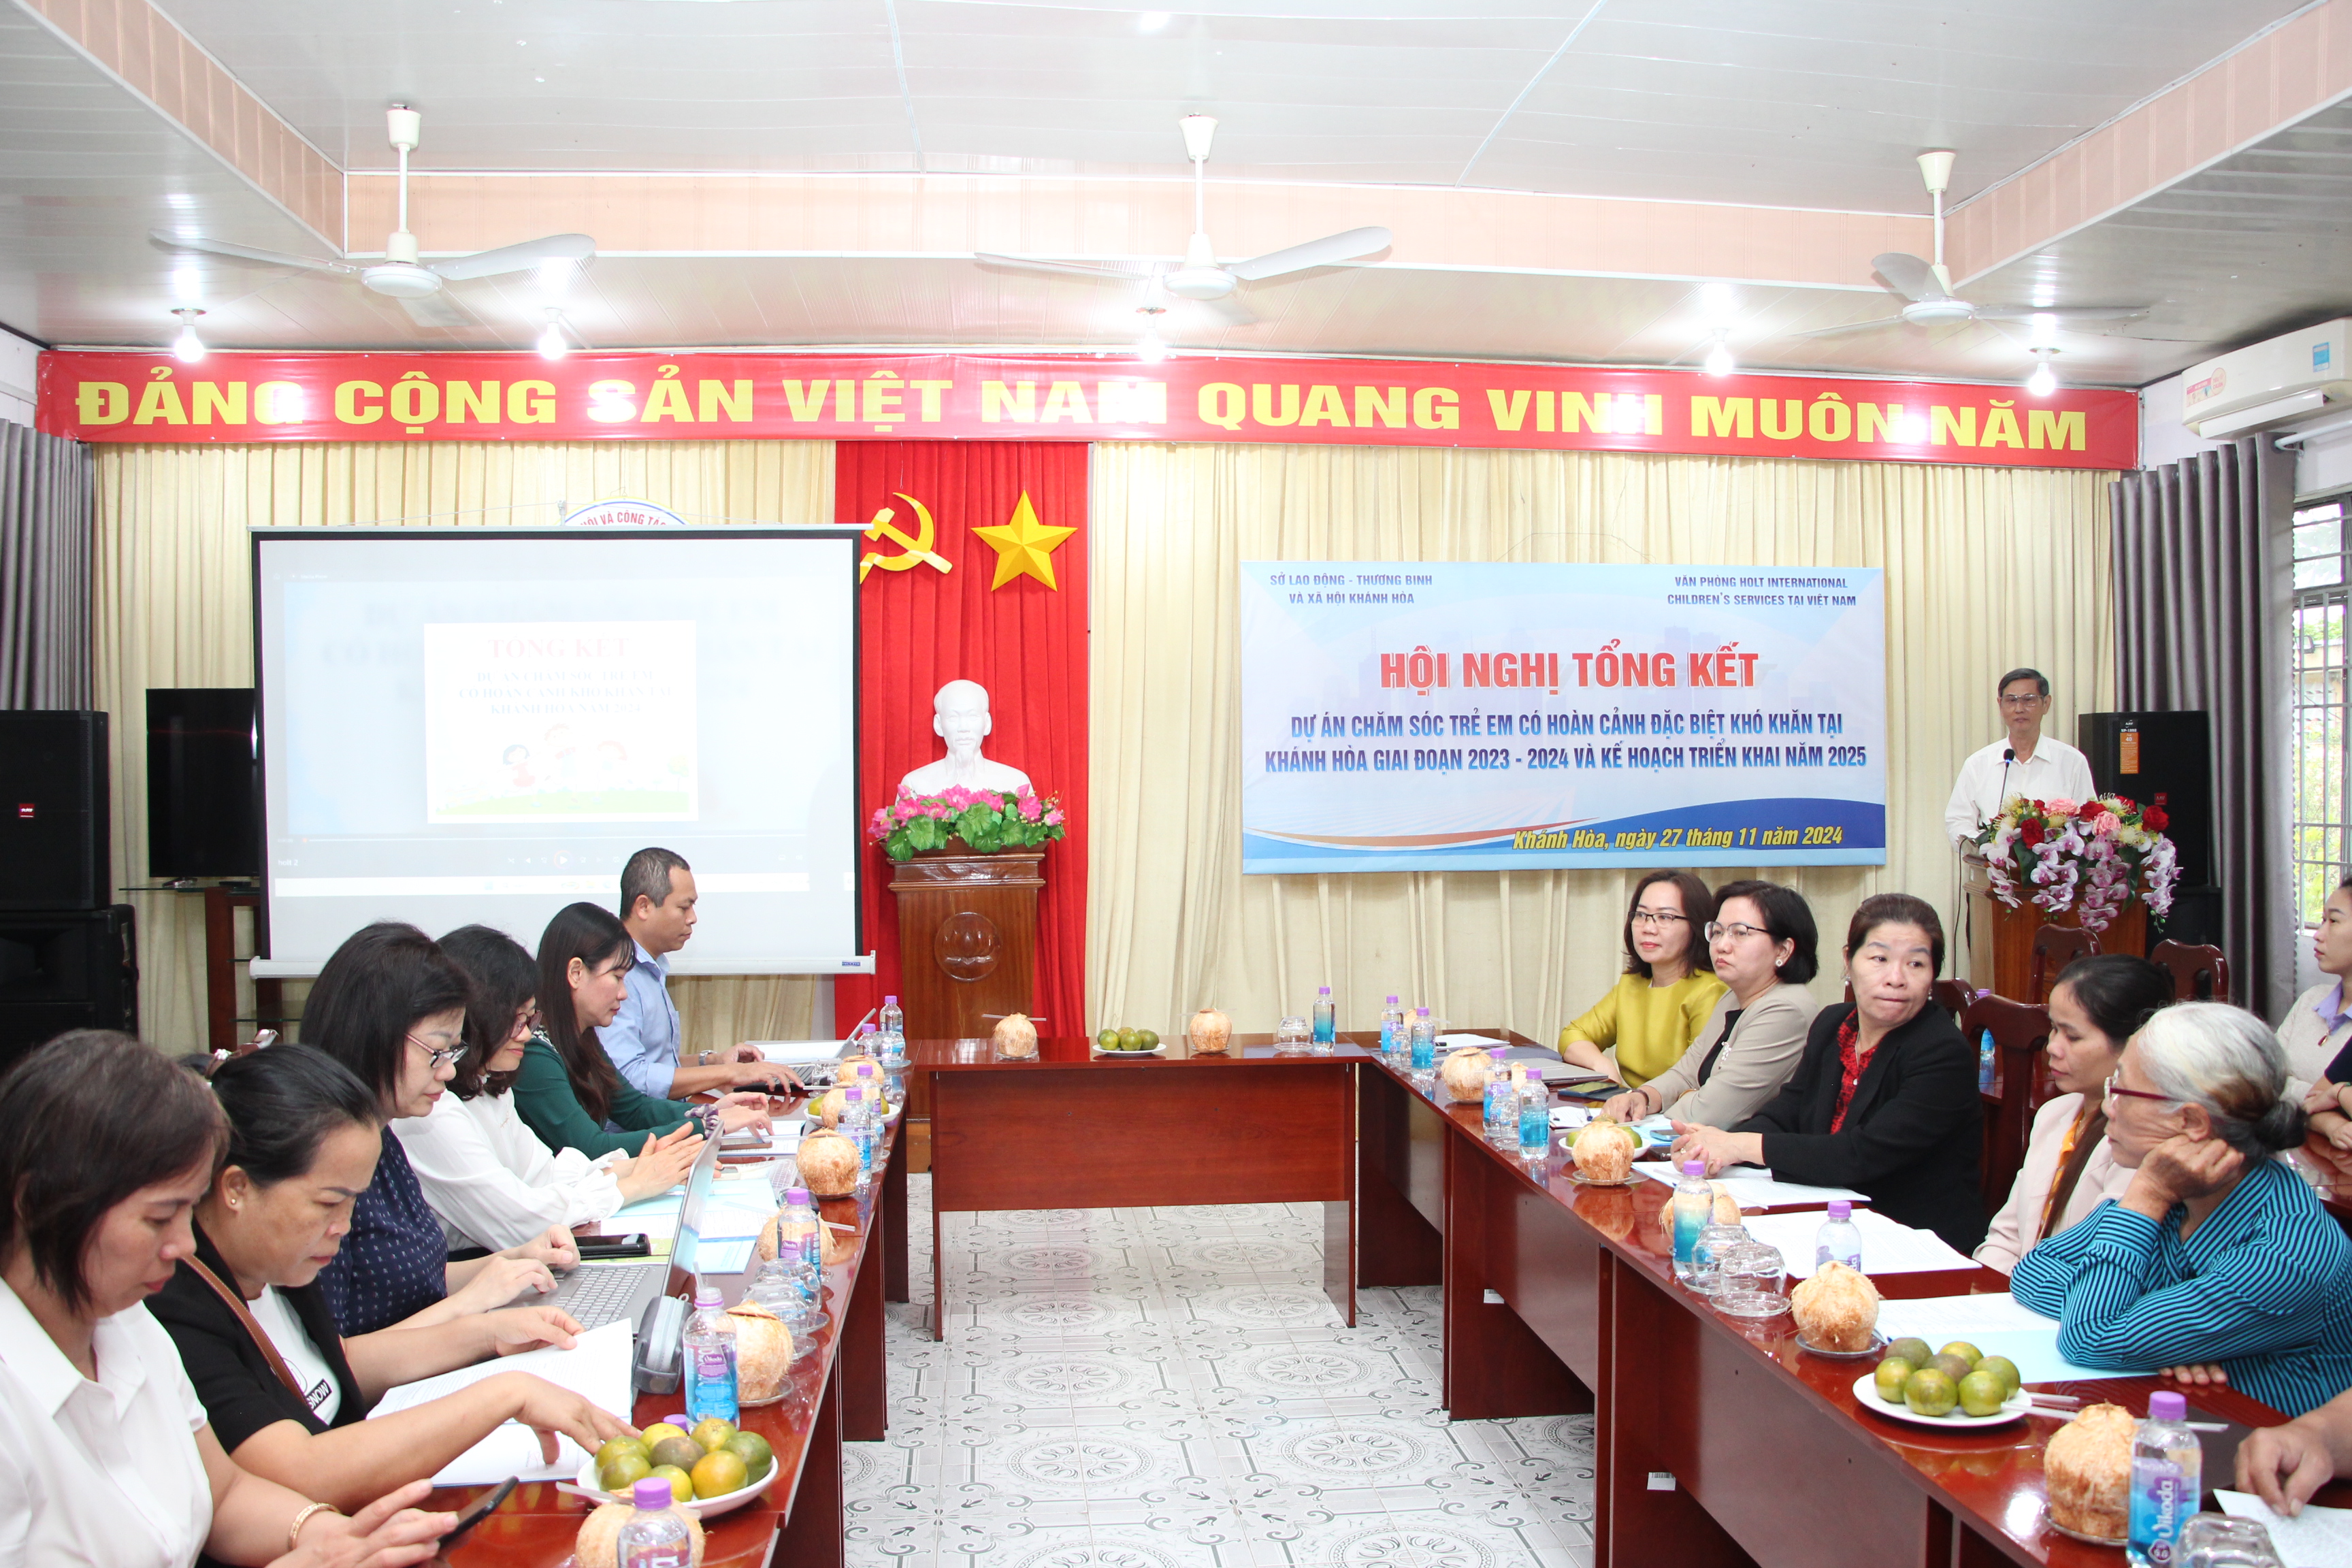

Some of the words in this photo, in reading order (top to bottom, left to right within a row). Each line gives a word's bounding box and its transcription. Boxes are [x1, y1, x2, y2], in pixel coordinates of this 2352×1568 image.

[76, 366, 304, 425] ĐẢNG
[334, 371, 556, 434] CỘNG
[587, 364, 753, 423] SẢN
[782, 371, 953, 431] VIỆT
[981, 379, 1167, 424] NAM
[1198, 382, 1459, 430] QUANG
[1486, 389, 1662, 436] VINH
[1691, 392, 1910, 444] MUÔN
[1930, 399, 2085, 451] NĂM
[600, 512, 614, 525] VÀ
[617, 510, 644, 525] CÔNG
[1270, 572, 1286, 585] SỞ
[1289, 574, 1309, 585] LAO
[1313, 573, 1345, 587] ĐỘNG
[1356, 574, 1402, 585] THƯƠNG
[1405, 575, 1433, 585] BINH
[1675, 574, 1697, 587] VĂN
[1700, 574, 1737, 588] PHÒNG
[1740, 577, 1765, 588] HOLT
[1767, 577, 1848, 589] INTERNATIONAL
[1289, 591, 1304, 604] VÀ
[1307, 591, 1323, 604] XÃ
[1326, 591, 1345, 606] HỘI
[1349, 591, 1388, 604] KHÁNH
[1392, 591, 1414, 604] HÒA
[1734, 594, 1784, 606] SERVICES
[1787, 595, 1804, 607] TẠI
[1807, 593, 1829, 608] VIỆT
[1832, 595, 1856, 606] NAM
[1380, 645, 1450, 696] HỘI
[1463, 652, 1559, 696] NGHỊ
[1571, 638, 1676, 687] TỔNG
[1687, 642, 1759, 687] KẾT
[1291, 714, 1316, 742] DỰ
[1321, 712, 1345, 738] ÁN
[1351, 712, 1403, 737] CHĂM
[1409, 710, 1443, 736] SÓC
[1450, 707, 1480, 736] TRẺ
[1486, 715, 1513, 736] EM
[1519, 710, 1541, 736] CÓ
[1547, 710, 1594, 736] HOÀN
[1599, 706, 1646, 735] CẢNH
[1651, 709, 1684, 739] ĐẶC
[1690, 710, 1725, 739] BIỆT
[1730, 709, 1763, 734] KHÓ
[1769, 709, 1812, 734] KHĂN
[1818, 713, 1843, 738] TẠI
[1265, 747, 1326, 772] KHÁNH
[1332, 745, 1368, 772] HÒA
[1373, 749, 1408, 771] GIAI
[1414, 749, 1463, 775] ĐOẠN
[1467, 748, 1509, 770] 2023
[1527, 748, 1569, 770] 2024
[1574, 743, 1596, 768] VÀ
[1601, 740, 1624, 768] KẾ
[1628, 745, 1684, 773] HOẠCH
[1688, 738, 1736, 768] TRIỂN
[1742, 746, 1780, 768] KHAI
[1786, 742, 1823, 767] NĂM
[1828, 745, 1866, 766] 2025
[1512, 830, 1569, 850] Khánh
[1572, 829, 1610, 850] Hòa,
[1614, 828, 1657, 850] ngày
[1659, 828, 1682, 847] 27
[1685, 827, 1733, 849] tháng
[1739, 827, 1757, 846] 11
[1761, 826, 1799, 845] năm
[1801, 826, 1843, 845] 2024
